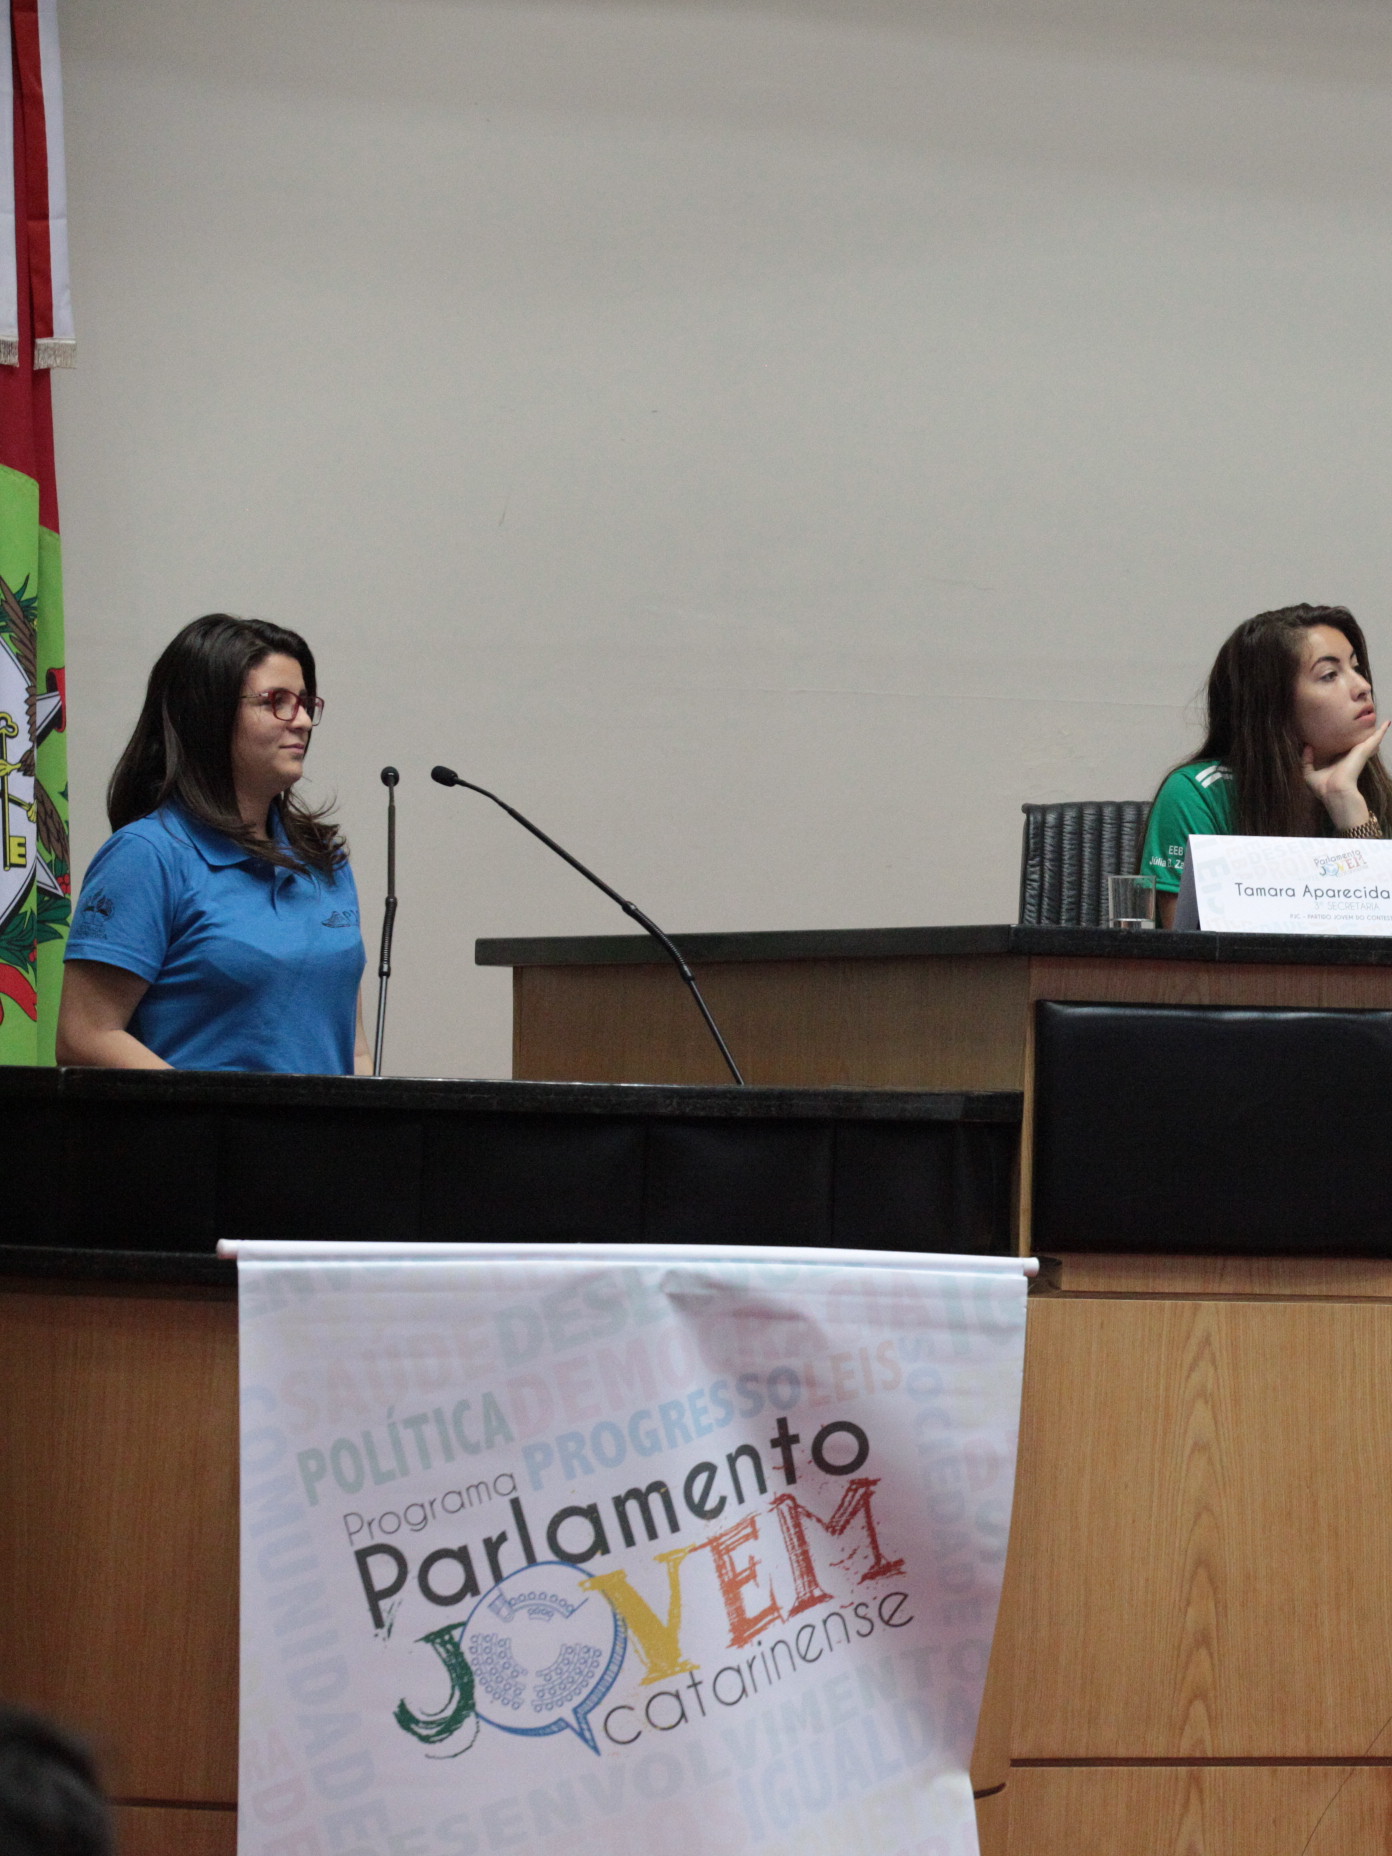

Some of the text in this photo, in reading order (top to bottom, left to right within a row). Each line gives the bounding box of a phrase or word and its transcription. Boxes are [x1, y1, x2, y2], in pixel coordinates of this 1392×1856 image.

[1234, 882, 1297, 898] Tamara
[1302, 884, 1391, 900] Aparecida
[523, 1366, 802, 1491] PROGRESSO
[803, 1340, 903, 1408] LEIS
[297, 1391, 515, 1506] POLÍTICA
[343, 1472, 517, 1546] Programa
[353, 1416, 871, 1630] Parlamento
[393, 1476, 909, 1758] JOVEM
[603, 1590, 915, 1746] catarinense
